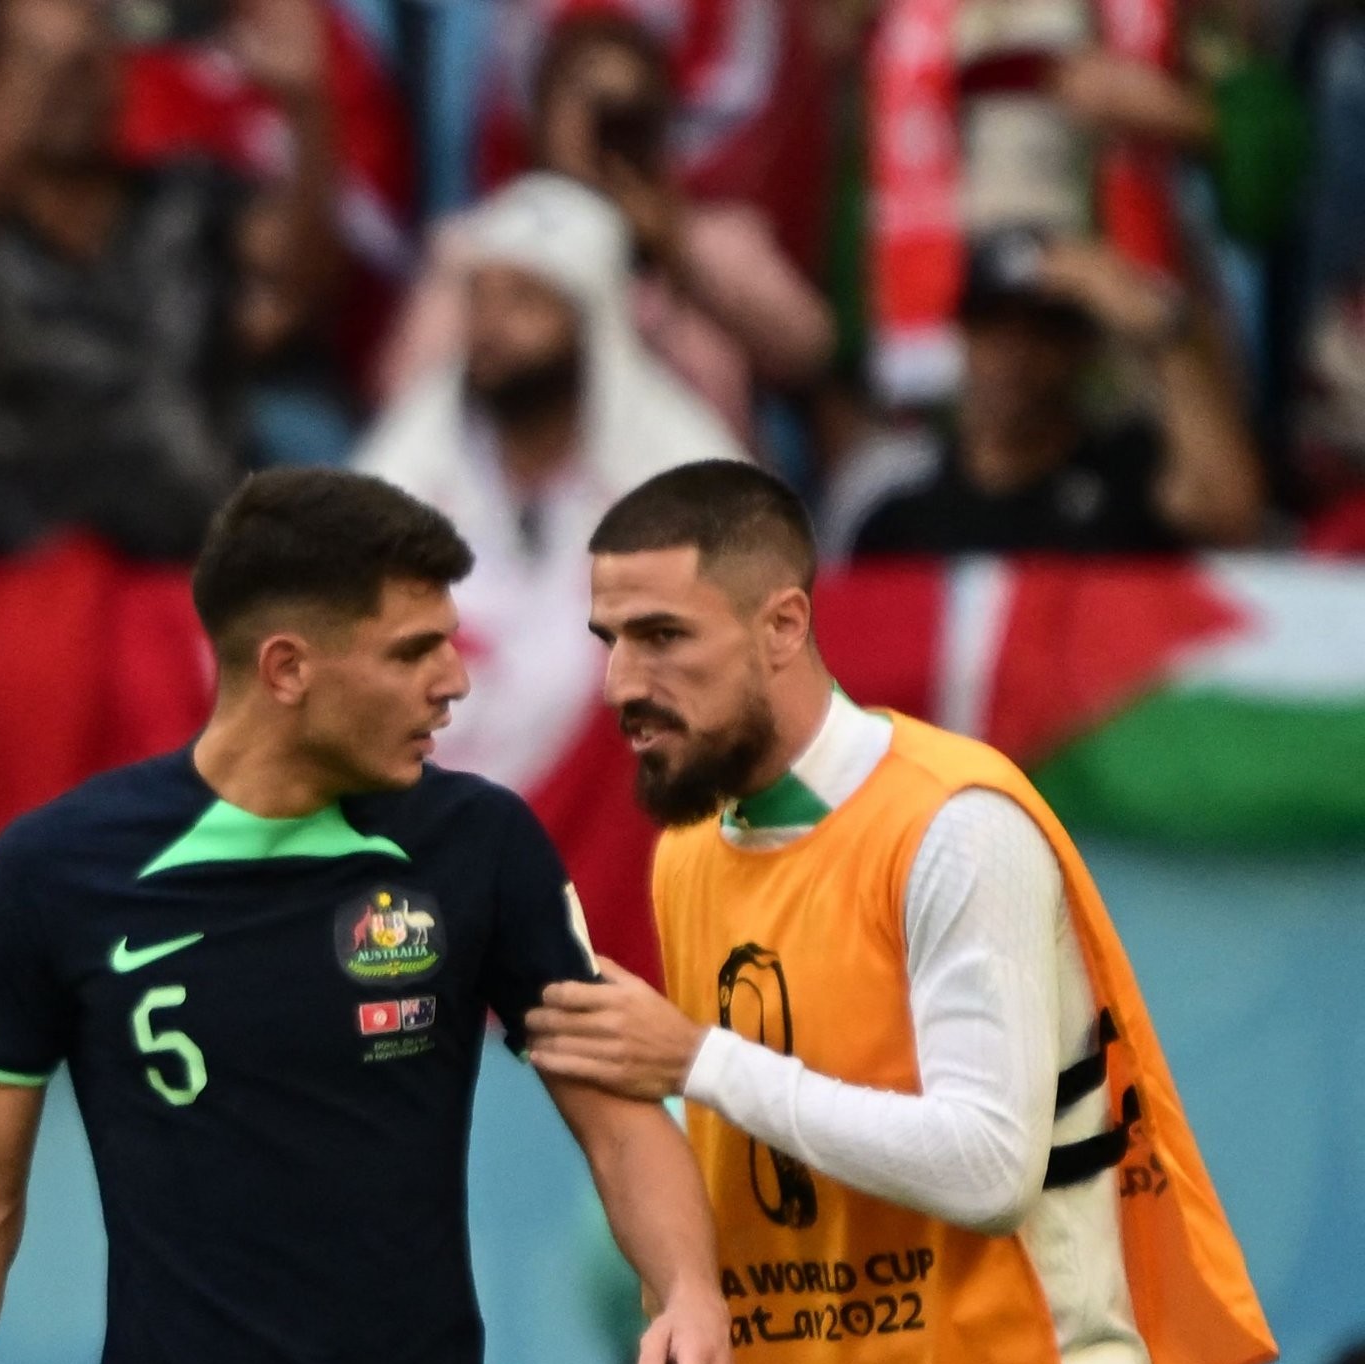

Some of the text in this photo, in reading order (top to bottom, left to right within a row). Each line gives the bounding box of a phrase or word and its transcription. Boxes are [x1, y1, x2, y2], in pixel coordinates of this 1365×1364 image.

[357, 945, 429, 963] AUSTRALIA
[131, 984, 208, 1106] 5
[747, 1261, 858, 1296] WORLD
[864, 1247, 934, 1287] CUP
[729, 1291, 926, 1348] atar2022
